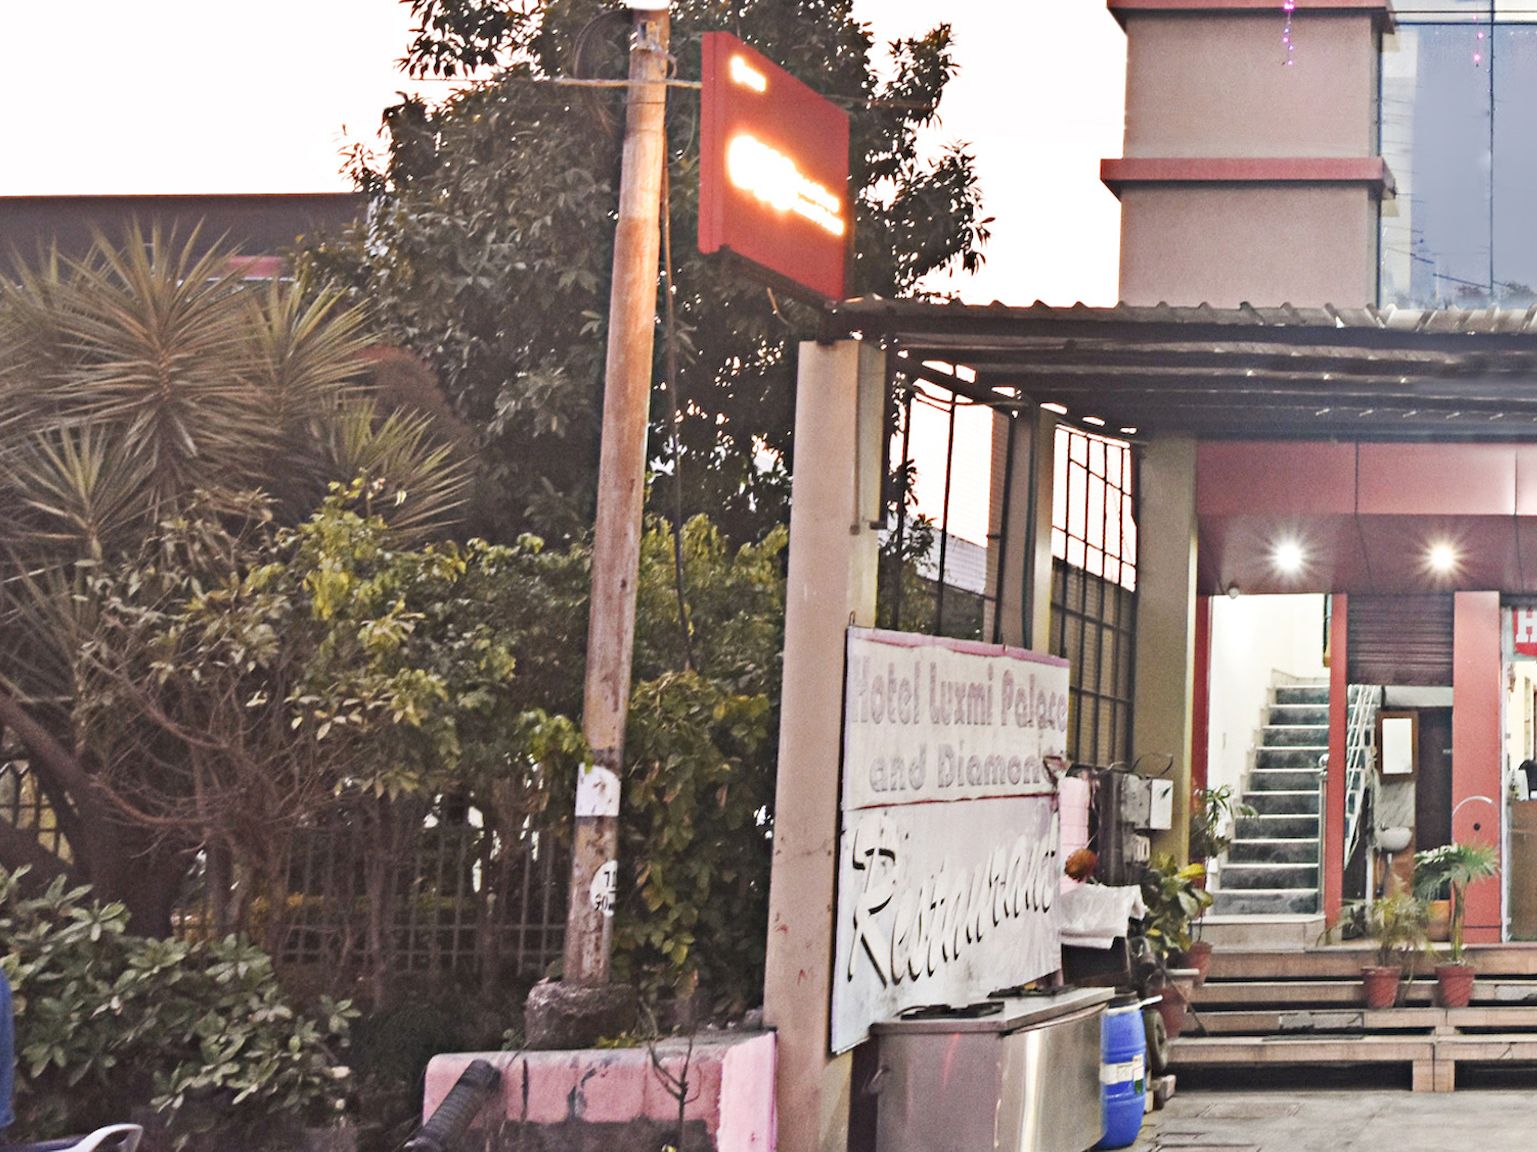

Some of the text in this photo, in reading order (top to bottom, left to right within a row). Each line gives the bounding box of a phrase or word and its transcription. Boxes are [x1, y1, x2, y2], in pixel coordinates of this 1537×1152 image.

[851, 655, 921, 726] Hotel
[1001, 669, 1067, 732] Palace
[869, 742, 927, 792] and
